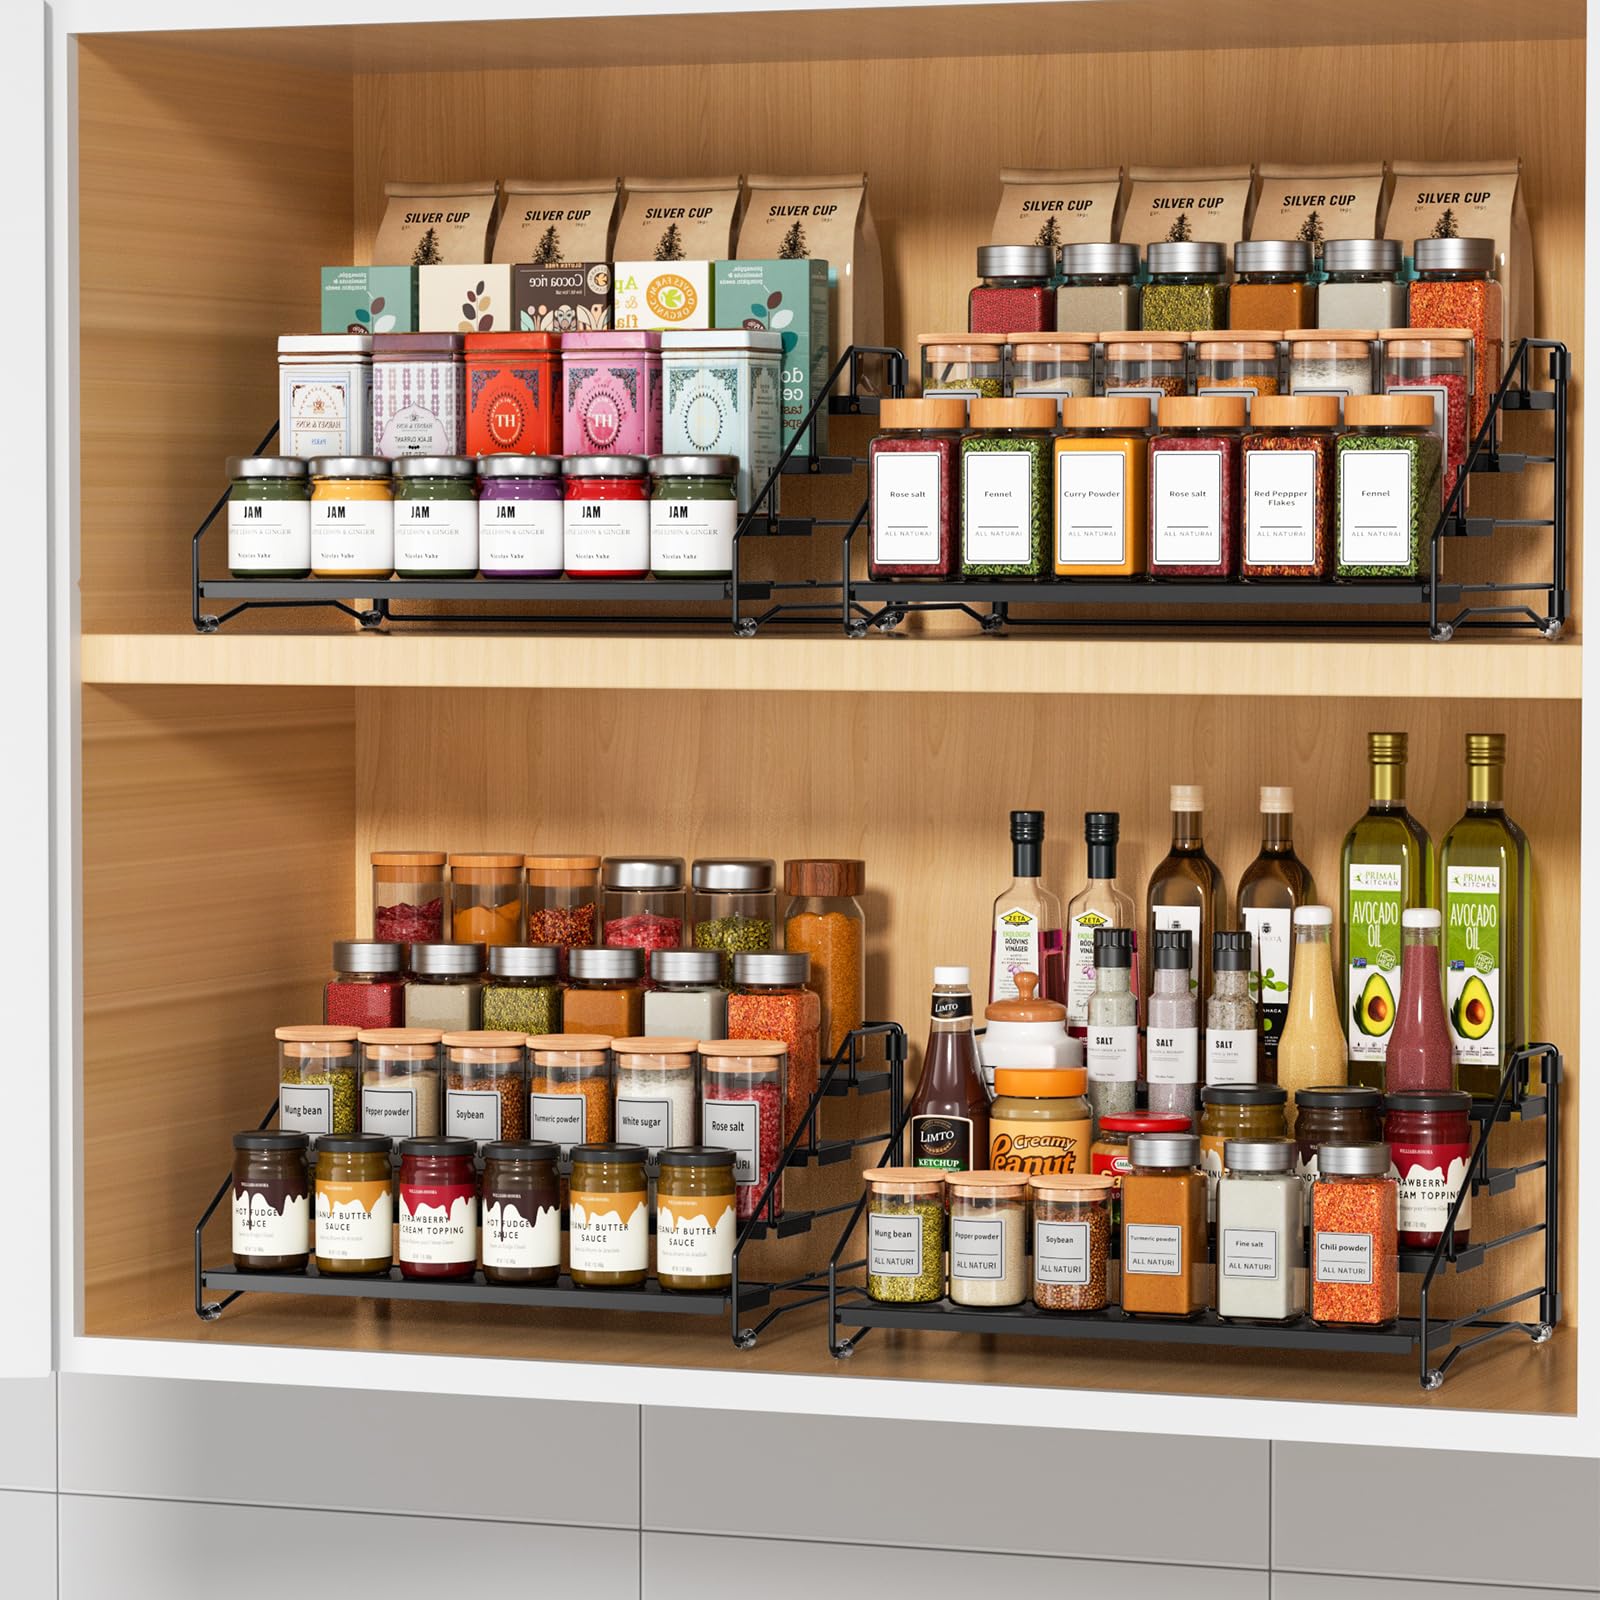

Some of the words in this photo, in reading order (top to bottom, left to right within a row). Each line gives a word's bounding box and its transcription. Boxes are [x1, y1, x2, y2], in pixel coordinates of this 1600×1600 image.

[1152, 198, 1194, 209] SILVER
[1198, 197, 1224, 209] CUP
[1282, 195, 1326, 207] SILVER
[1329, 195, 1356, 206] CUP
[1416, 192, 1460, 204] SILVER
[1464, 192, 1491, 203] CUP
[768, 205, 809, 217] SILVER
[812, 205, 838, 216] CUP
[1022, 200, 1064, 212] SILVER
[1067, 200, 1093, 210] CUP
[404, 212, 443, 224] SILVER
[446, 212, 470, 223] CUP
[524, 210, 564, 221] SILVER
[566, 210, 591, 220] CUP
[645, 208, 685, 219] SILVER
[688, 207, 713, 218] CUP
[1063, 490, 1087, 499] Curry
[1088, 490, 1120, 498] Powder
[1169, 490, 1190, 498] Rose
[1191, 490, 1207, 498] salt
[1254, 490, 1270, 498] Red
[244, 506, 262, 519] JAM
[327, 506, 346, 519] JAM
[411, 506, 430, 519] JAM
[496, 506, 516, 519] JAM
[582, 506, 601, 519] JAM
[669, 506, 688, 519] JAM
[1365, 871, 1397, 880] PRIMAL
[1463, 873, 1496, 882] PRIMAL
[1352, 901, 1399, 925] AVOCADO
[1450, 904, 1497, 928] AVOCADO
[1367, 923, 1382, 948] OIL
[1465, 926, 1480, 950] OIL
[1379, 951, 1396, 963] HIGH
[1477, 954, 1494, 966] HIGH
[1378, 959, 1395, 970] HEAT
[1476, 962, 1493, 973] HEAT
[935, 1003, 959, 1013] LIMTO
[1096, 1037, 1113, 1045] SALT
[1156, 1038, 1173, 1047] SALT
[1215, 1040, 1233, 1049] SALT
[284, 1104, 302, 1117] Mung
[302, 1105, 322, 1116] bean
[365, 1106, 383, 1116] Pepper
[384, 1107, 410, 1117] powder
[456, 1109, 485, 1121] Soybean
[534, 1113, 556, 1123] Turmeric
[556, 1115, 580, 1124] powder
[622, 1116, 640, 1126] White
[640, 1118, 662, 1129] sugar
[711, 1120, 728, 1131] Rose
[729, 1121, 745, 1132] salt
[920, 1130, 955, 1143] LIMTO
[1013, 1134, 1077, 1152] Creamy
[991, 1133, 1077, 1176] Peanut
[918, 1158, 960, 1167] KETCHUP
[250, 1208, 277, 1217] FUDGE
[339, 1211, 372, 1220] BUTTER
[241, 1219, 267, 1228] SAUCE
[401, 1214, 449, 1224] STRAWBERRY
[502, 1219, 530, 1228] FUDGE
[325, 1222, 351, 1232] SAUCE
[402, 1226, 423, 1234] CREAM
[427, 1226, 464, 1235] TOPPING
[595, 1223, 629, 1232] BUTTER
[683, 1227, 717, 1236] BUTTER
[493, 1230, 519, 1240] SAUCE
[581, 1234, 607, 1243] SAUCE
[874, 1229, 892, 1239] Mung
[892, 1230, 912, 1238] bean
[955, 1231, 973, 1240] Pepper
[974, 1232, 999, 1241] powder
[668, 1238, 695, 1247] SAUCE
[1046, 1235, 1074, 1245] Soybean
[1320, 1243, 1337, 1251] Chili
[1338, 1244, 1368, 1253] powder
[874, 1257, 885, 1265] ALL
[957, 1261, 968, 1269] ALL
[1229, 1262, 1242, 1270] ALL
[1040, 1264, 1052, 1273] ALL
